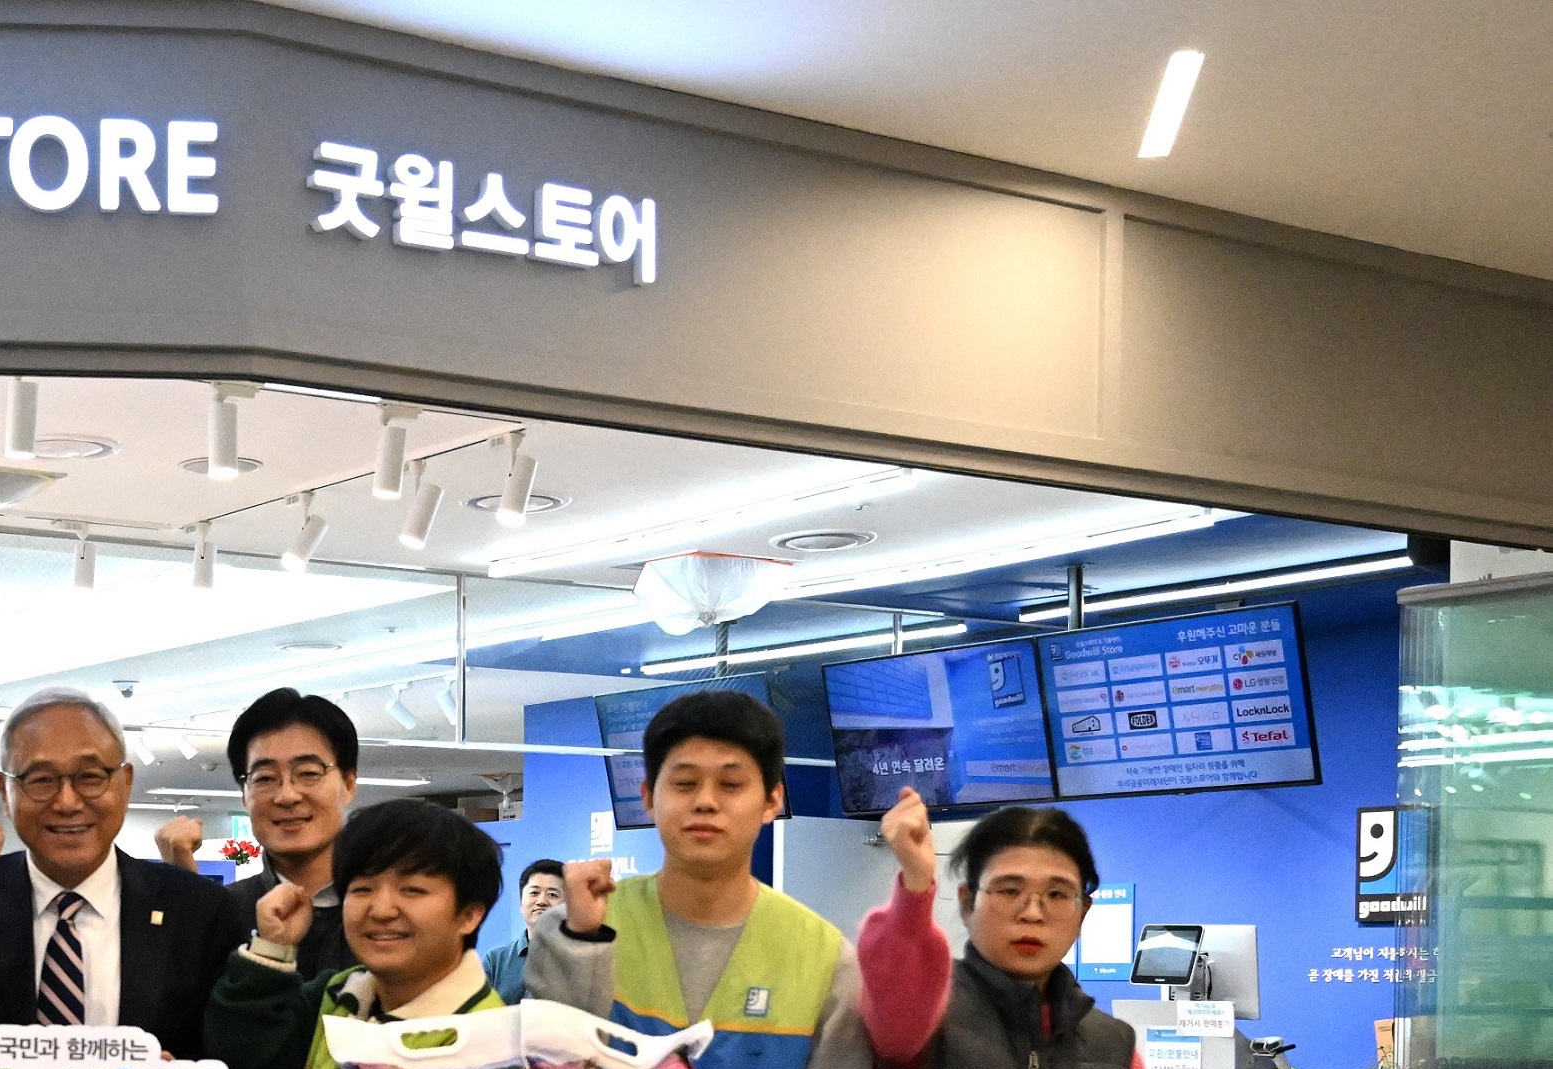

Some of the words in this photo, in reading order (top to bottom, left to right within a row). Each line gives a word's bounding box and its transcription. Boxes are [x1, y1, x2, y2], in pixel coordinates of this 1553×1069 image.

[309, 140, 657, 286] 굿윌스토어
[1177, 626, 1226, 642] 후원해주신
[1228, 622, 1257, 635] 고마운
[1065, 647, 1100, 660] Goodwill
[1102, 645, 1123, 655] Store
[1244, 679, 1256, 688] LG
[1236, 704, 1290, 718] LocknLock
[1251, 730, 1289, 743] Tefal
[914, 757, 945, 773] 달려온
[1359, 896, 1427, 919] goodwill
[1330, 947, 1374, 961] 고객님이
[1322, 969, 1354, 982] 장애를
[1357, 968, 1379, 982] 가진
[66, 1036, 150, 1062] 함께하는
